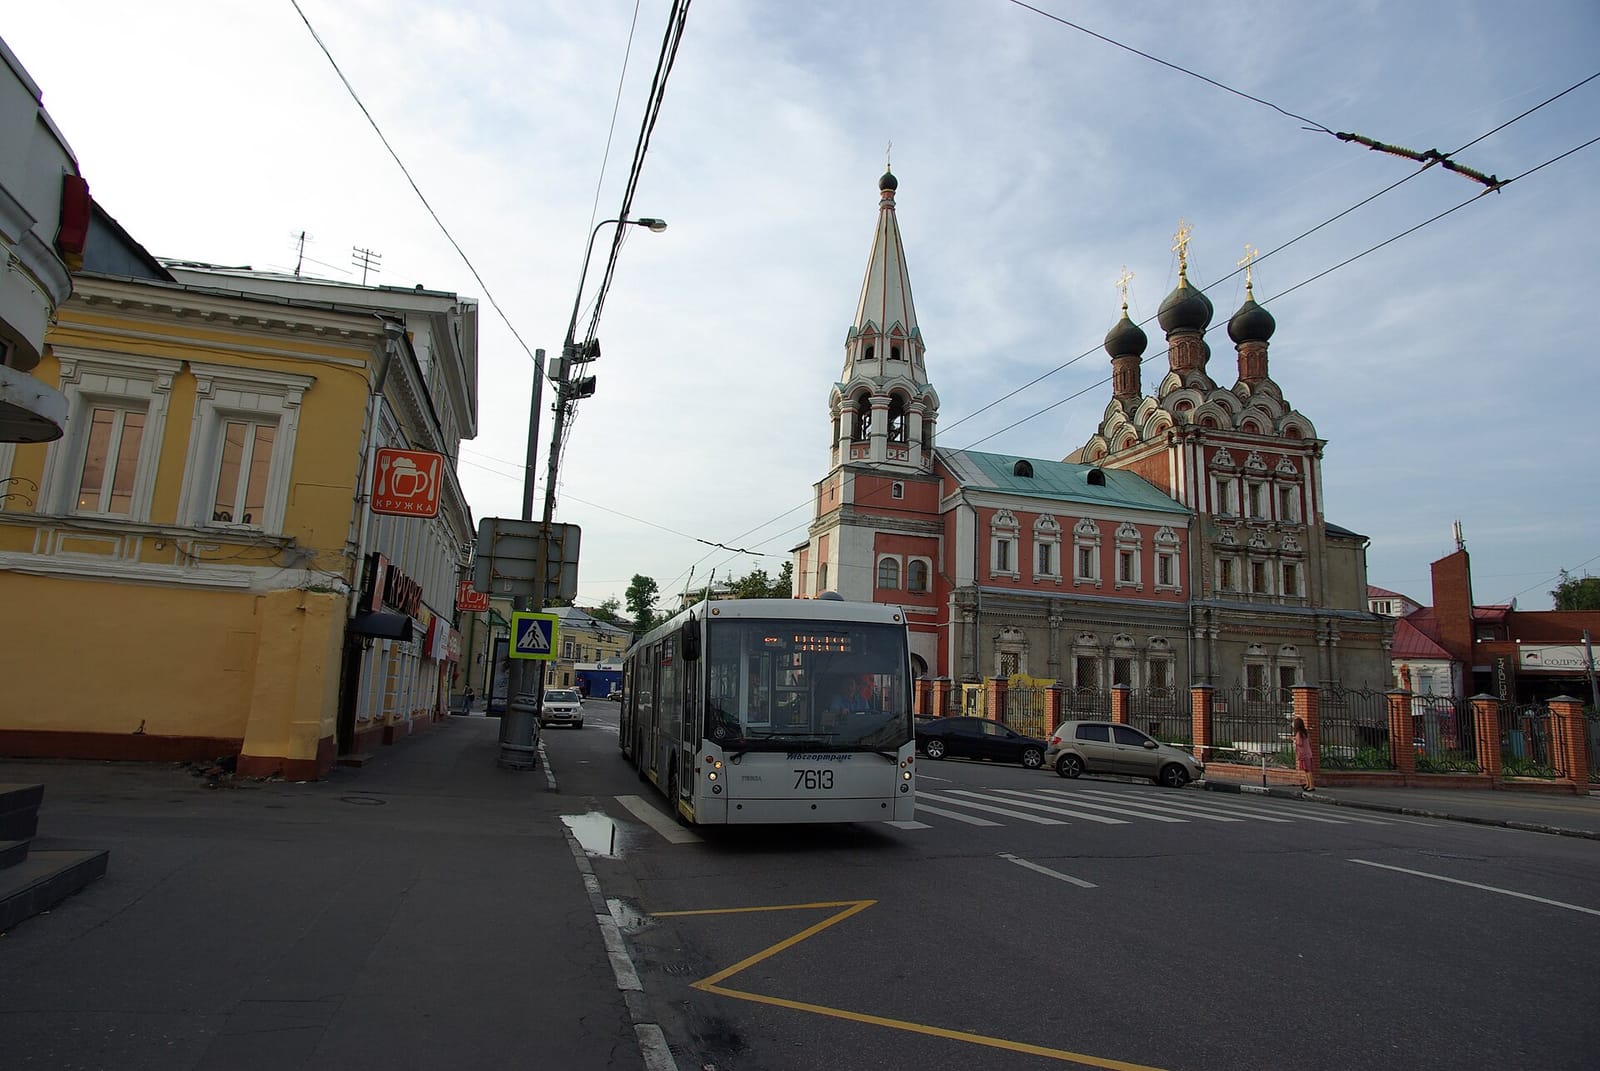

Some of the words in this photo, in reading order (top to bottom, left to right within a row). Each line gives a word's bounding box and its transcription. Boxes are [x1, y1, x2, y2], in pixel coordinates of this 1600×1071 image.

[376, 499, 433, 512] КРУЖКА
[389, 566, 424, 618] КРУЖК
[793, 769, 834, 790] 7613
